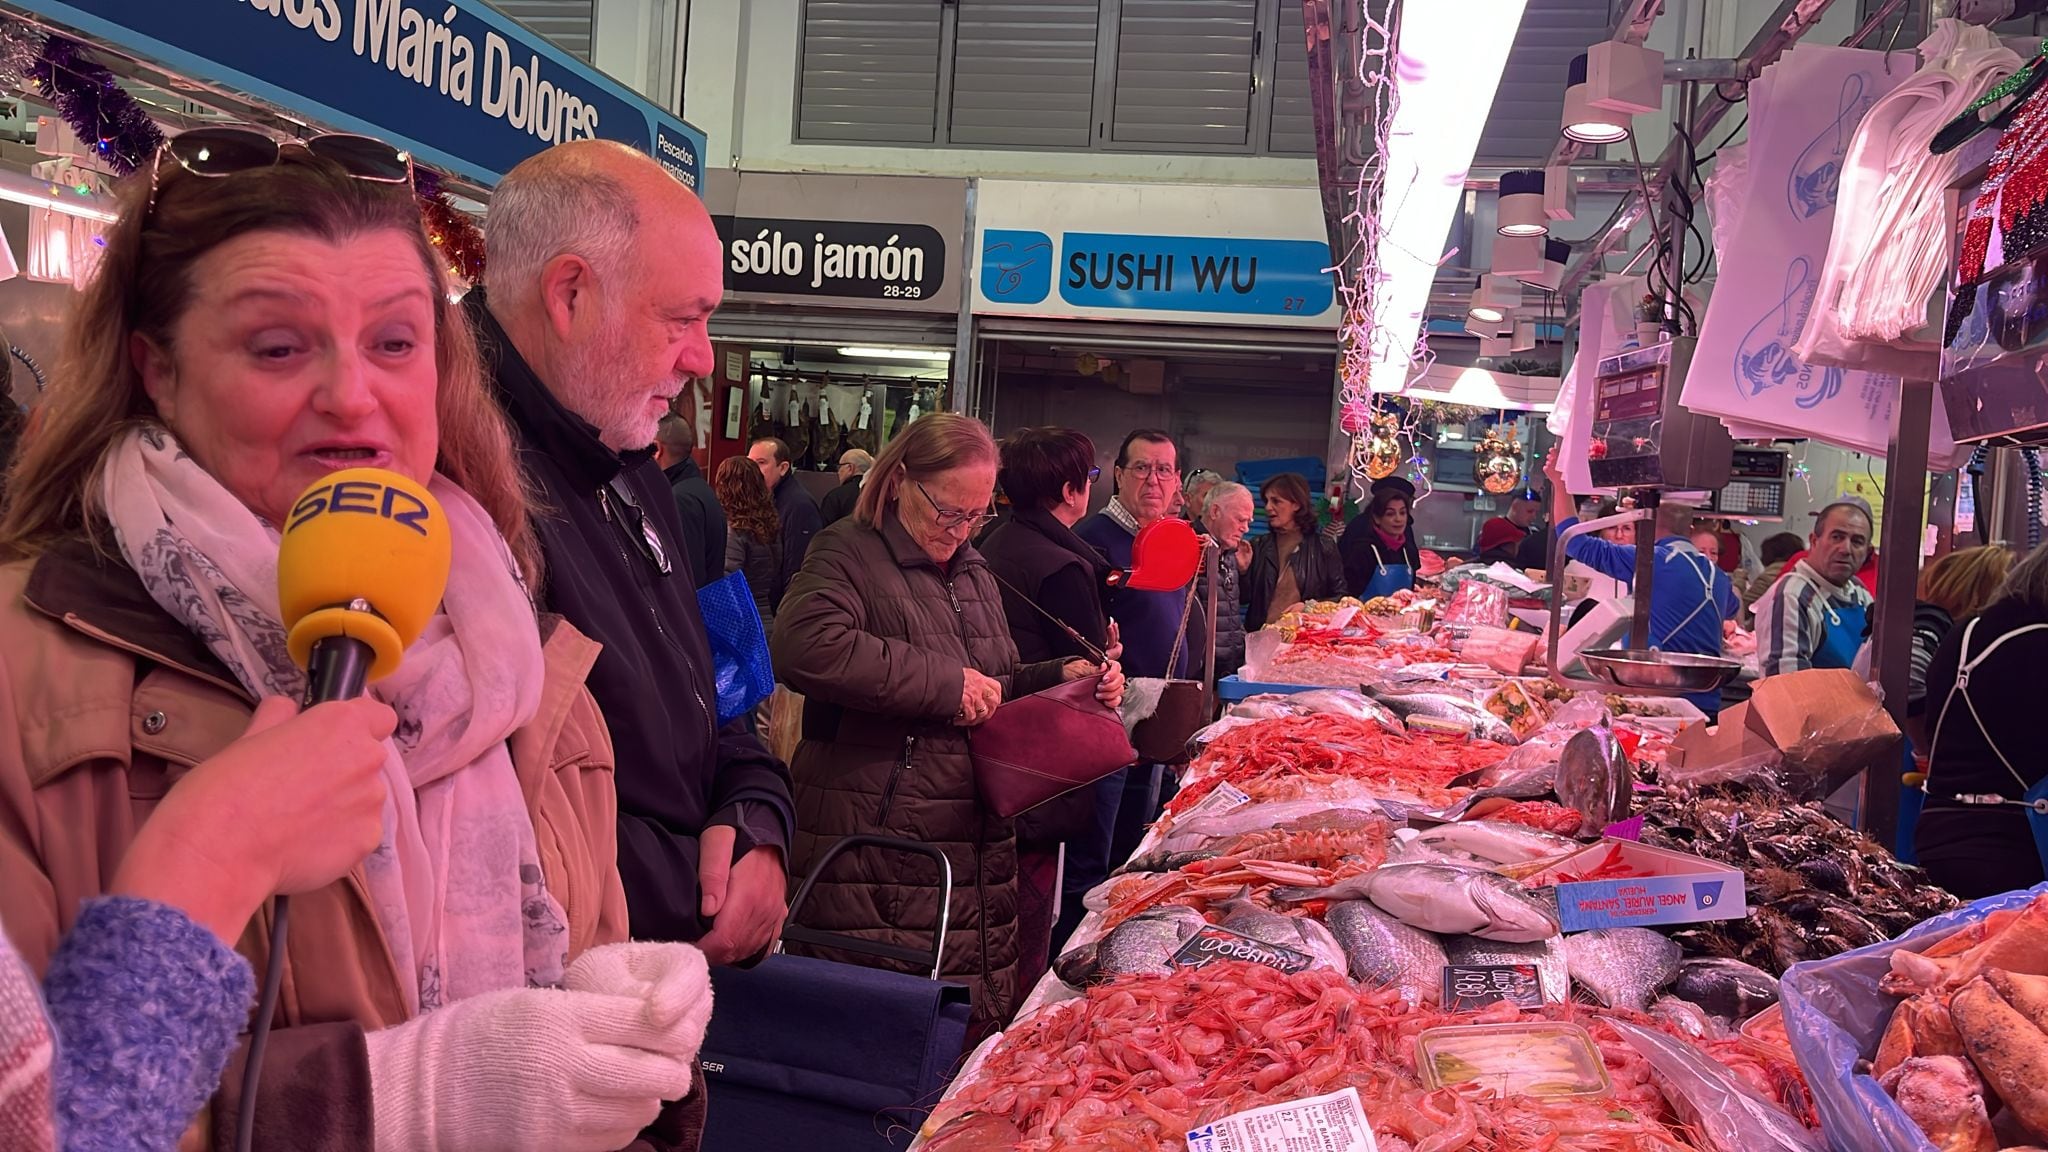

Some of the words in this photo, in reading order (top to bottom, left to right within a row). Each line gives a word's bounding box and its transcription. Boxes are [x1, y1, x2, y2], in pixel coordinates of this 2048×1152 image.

[353, 0, 474, 106] María
[481, 31, 598, 146] Dolores
[658, 133, 693, 166] Pescados
[663, 160, 695, 187] mariscos
[731, 229, 803, 276] sólo
[811, 232, 924, 288] jamón
[1068, 251, 1174, 292] SUSHI
[1191, 255, 1258, 294] WU
[883, 285, 921, 298] 28-29
[1283, 298, 1305, 311] 27
[287, 481, 429, 537] SER
[1623, 896, 1656, 909] MURIEL
[1658, 893, 1687, 907] ANGEL
